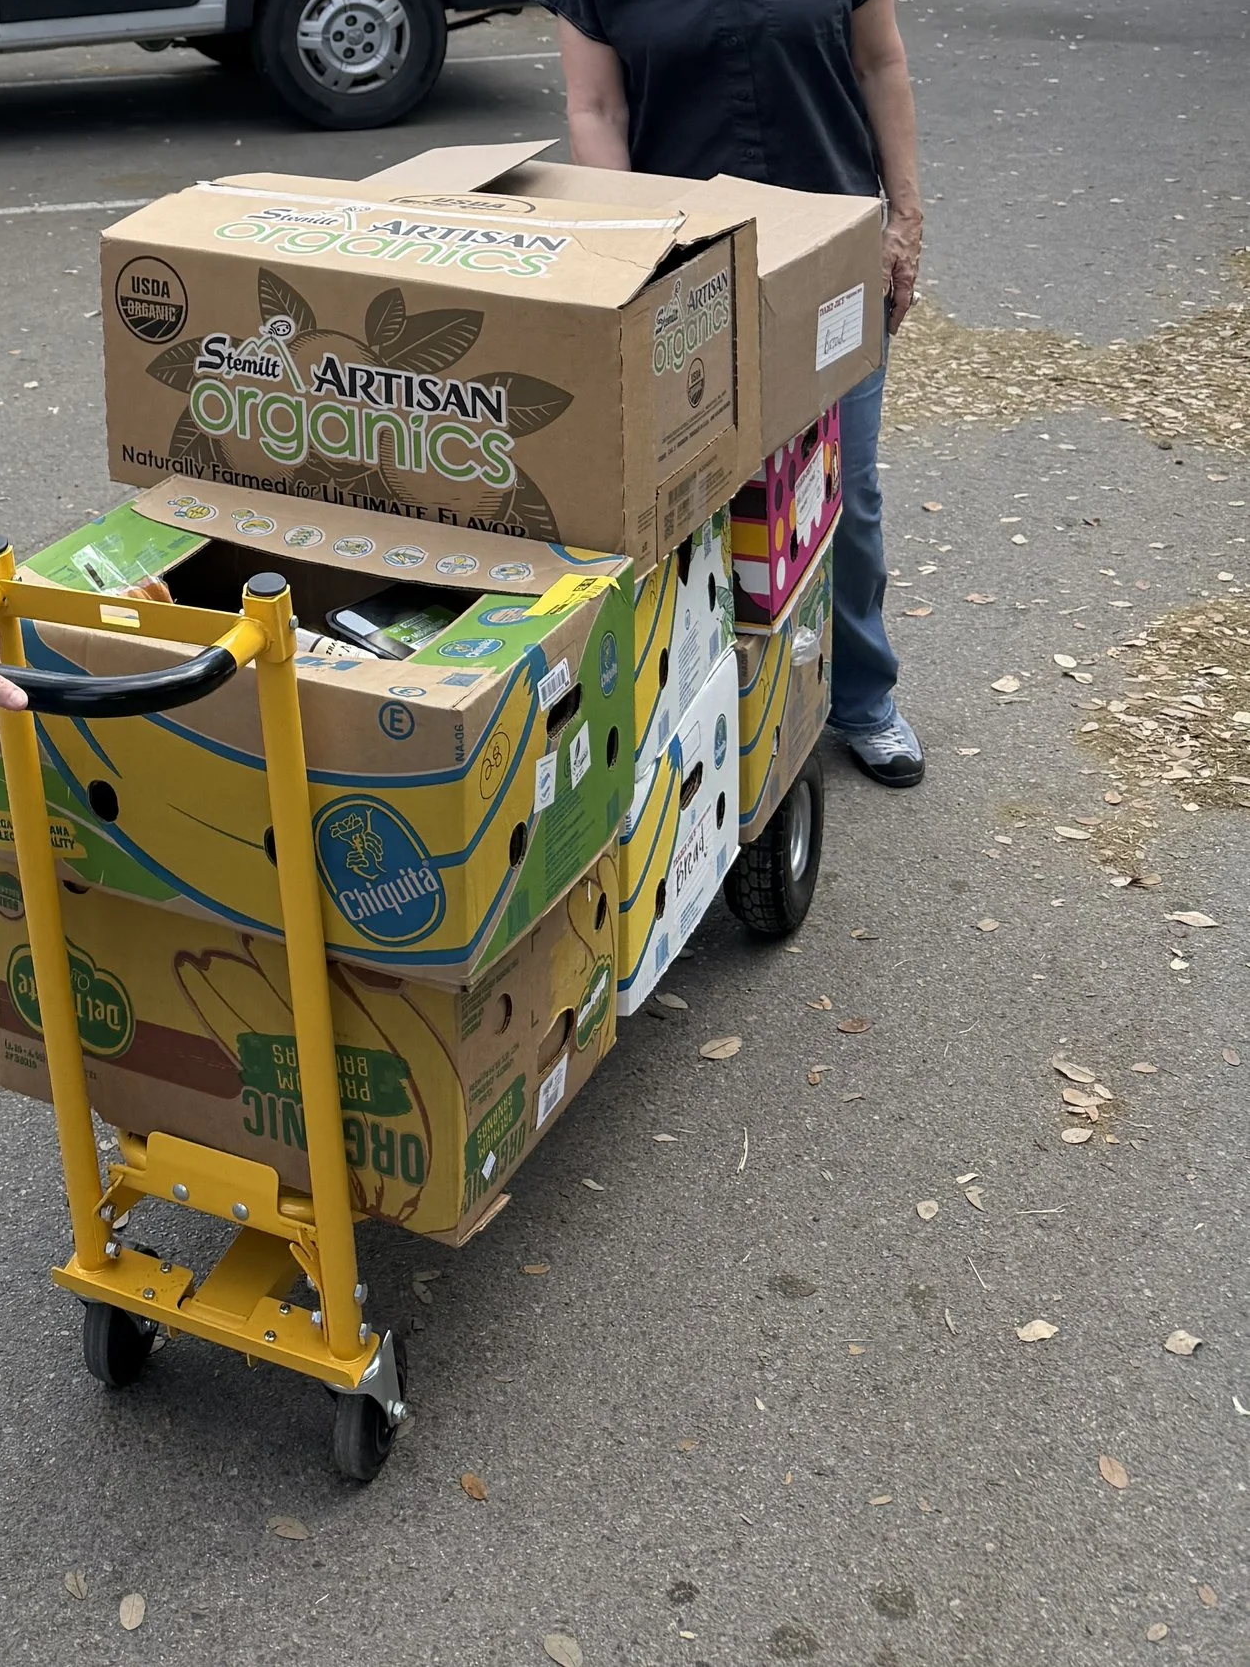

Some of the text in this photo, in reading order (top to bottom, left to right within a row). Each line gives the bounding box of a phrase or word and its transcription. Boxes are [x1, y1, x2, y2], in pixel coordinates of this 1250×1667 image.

[214, 220, 557, 278] organics
[247, 207, 572, 253] Stemilt ARTISAN
[126, 300, 177, 322] ORGANIC
[130, 274, 172, 299] USDA
[197, 335, 504, 424] Stemilt ARTISAN
[191, 381, 516, 487] organics
[121, 444, 206, 480] Naturally
[211, 463, 290, 496] Farmed
[295, 480, 320, 499] for
[388, 708, 405, 733] E
[339, 866, 440, 921] Chiquita
[86, 996, 122, 1031] Del
[272, 1043, 369, 1078] BAAS
[243, 1086, 426, 1186] ORGNIC
[462, 1120, 527, 1216] ORGNIC
